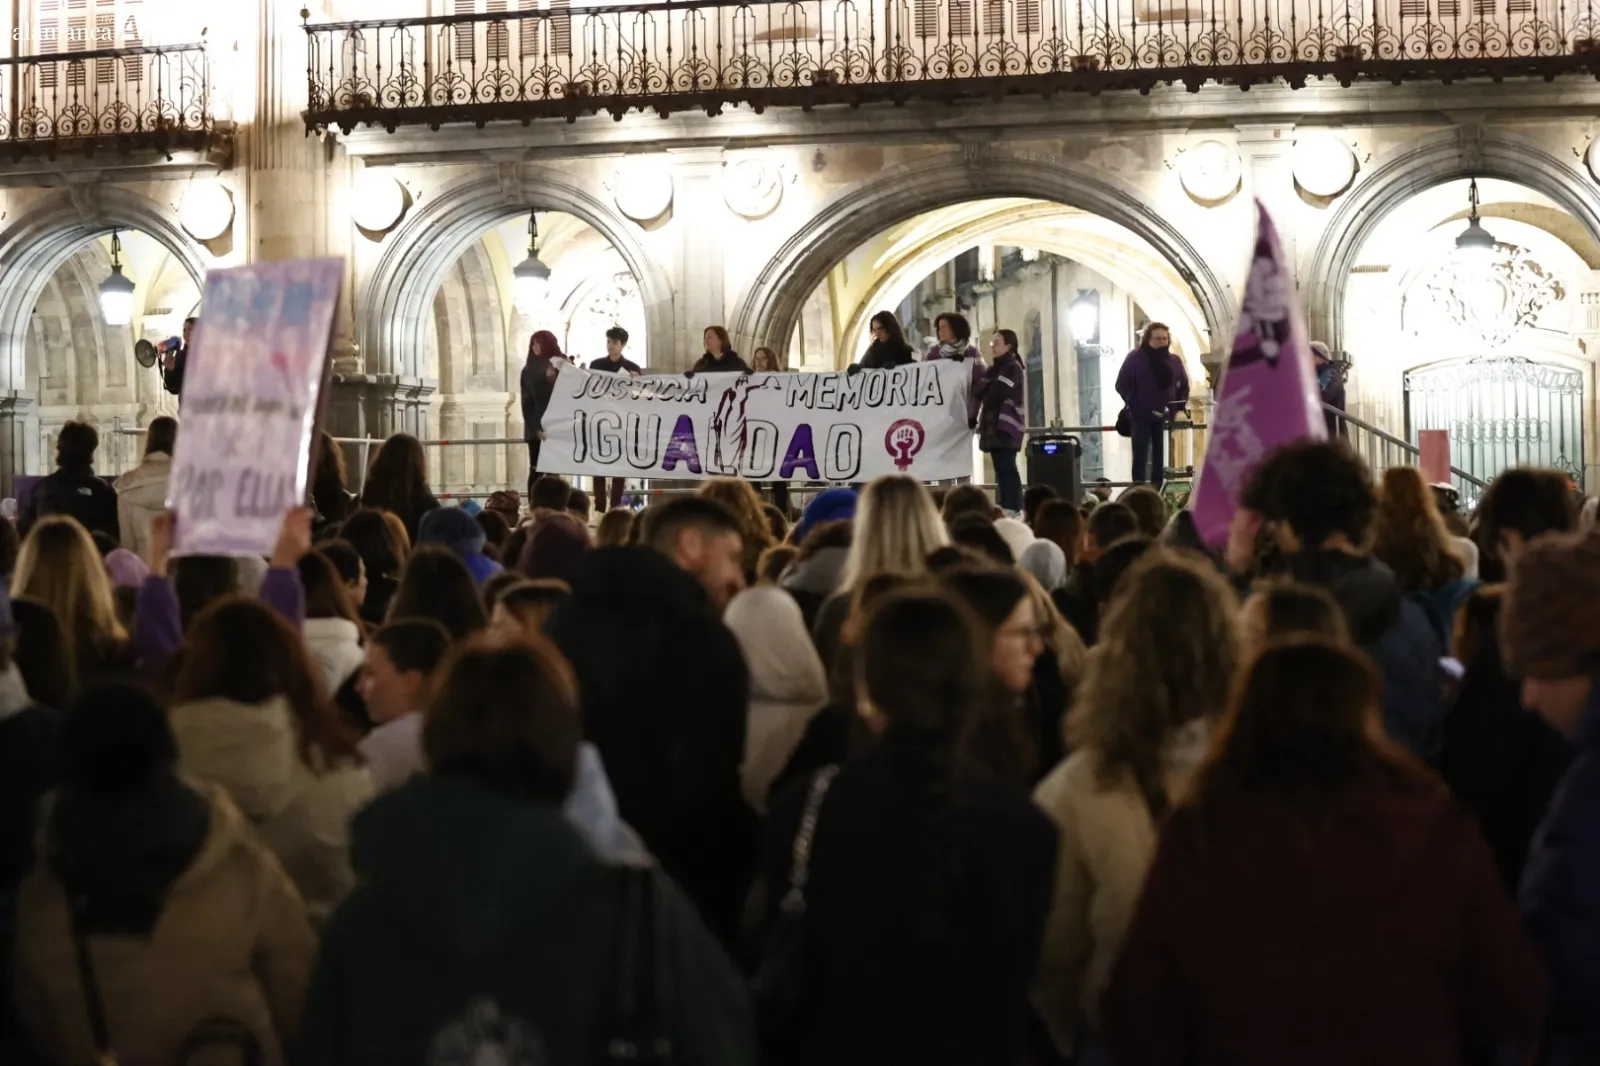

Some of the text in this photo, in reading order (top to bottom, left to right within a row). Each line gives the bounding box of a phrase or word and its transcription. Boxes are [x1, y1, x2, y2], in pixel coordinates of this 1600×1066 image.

[571, 365, 943, 412] JUSTICIA MEMORIA
[573, 409, 862, 481] IGUALDAD
